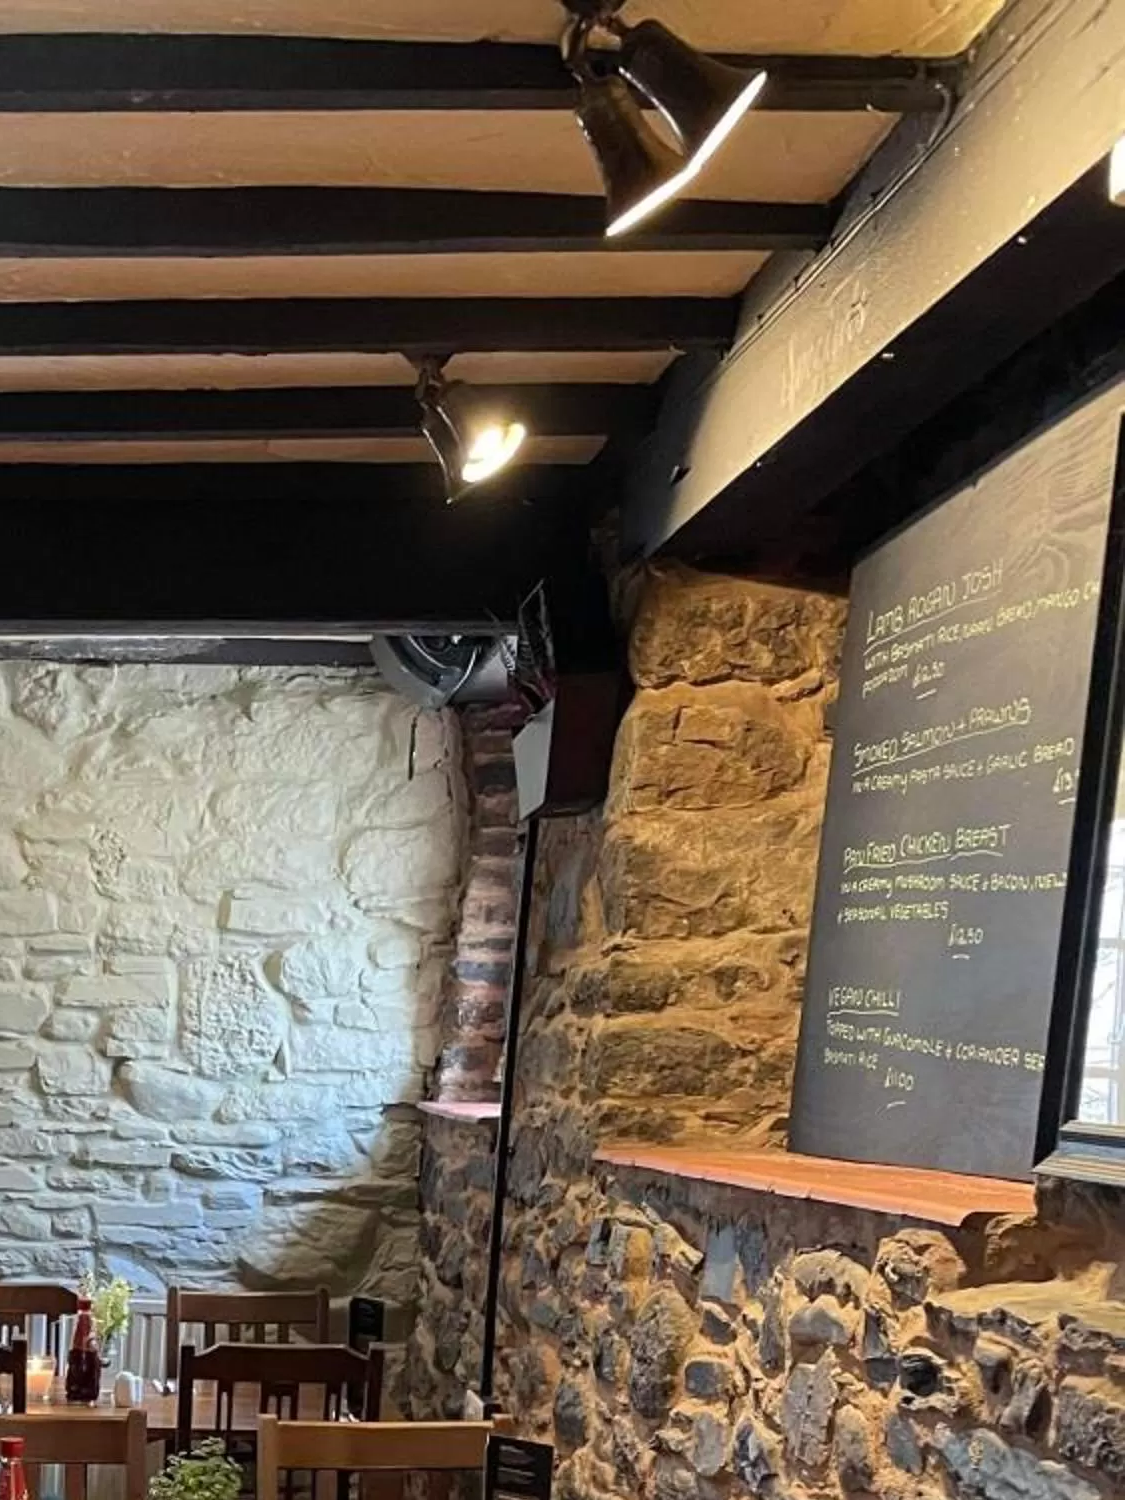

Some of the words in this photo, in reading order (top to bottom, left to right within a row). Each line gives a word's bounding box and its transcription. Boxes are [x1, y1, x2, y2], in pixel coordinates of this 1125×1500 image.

[866, 604, 904, 645] LAMB
[961, 557, 1003, 600] JOSH
[1033, 737, 1074, 764] BREAD
[899, 830, 952, 858] CHICKEN
[955, 822, 1012, 849] BREAST
